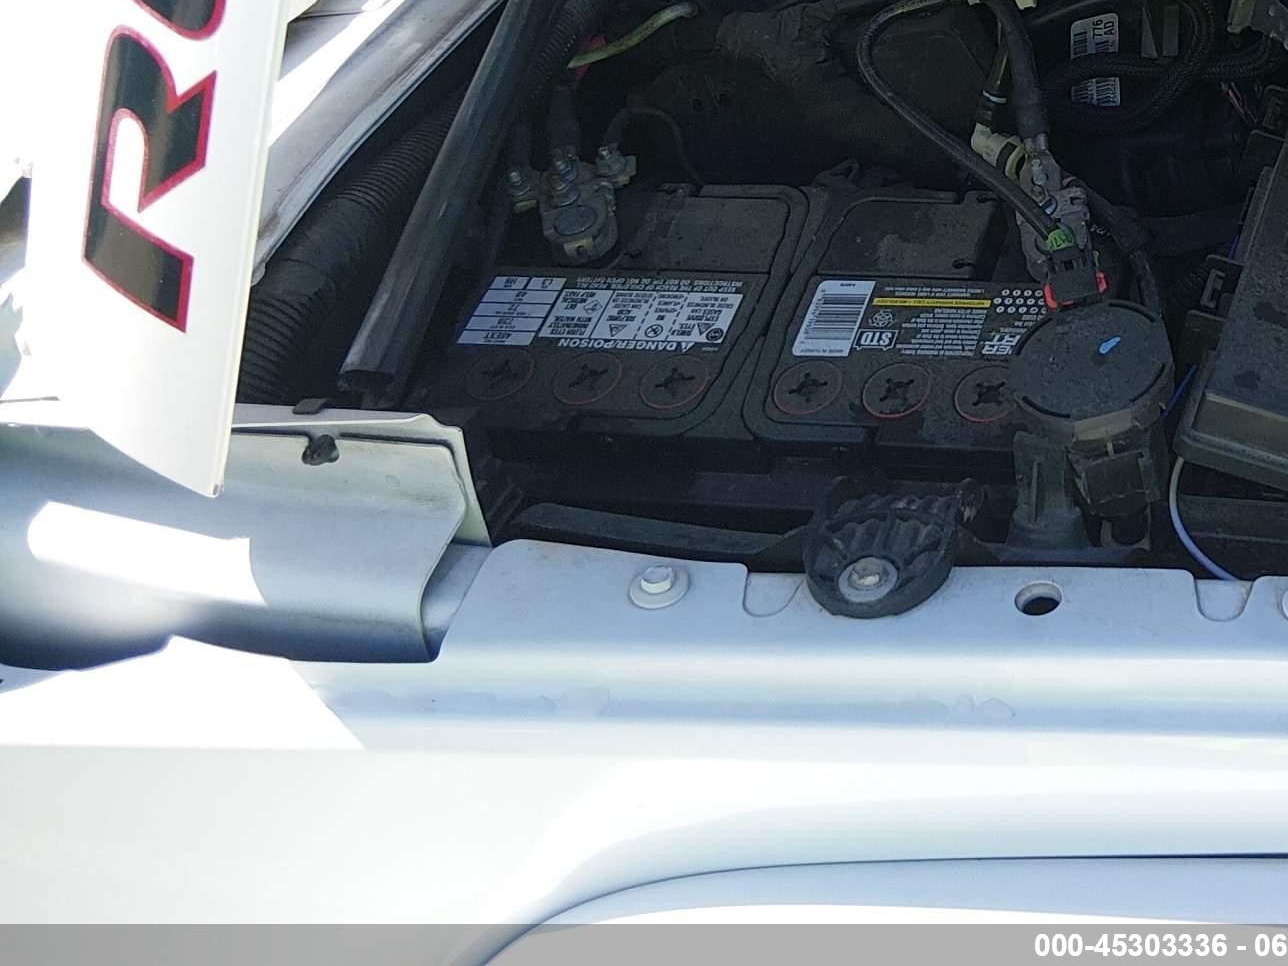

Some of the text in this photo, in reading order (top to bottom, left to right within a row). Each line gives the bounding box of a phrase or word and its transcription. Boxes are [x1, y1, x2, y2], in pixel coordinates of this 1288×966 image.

[1093, 19, 1103, 39] 776
[1103, 21, 1114, 35] AD
[557, 337, 678, 351] DANGER/POISON
[860, 332, 892, 345] STD
